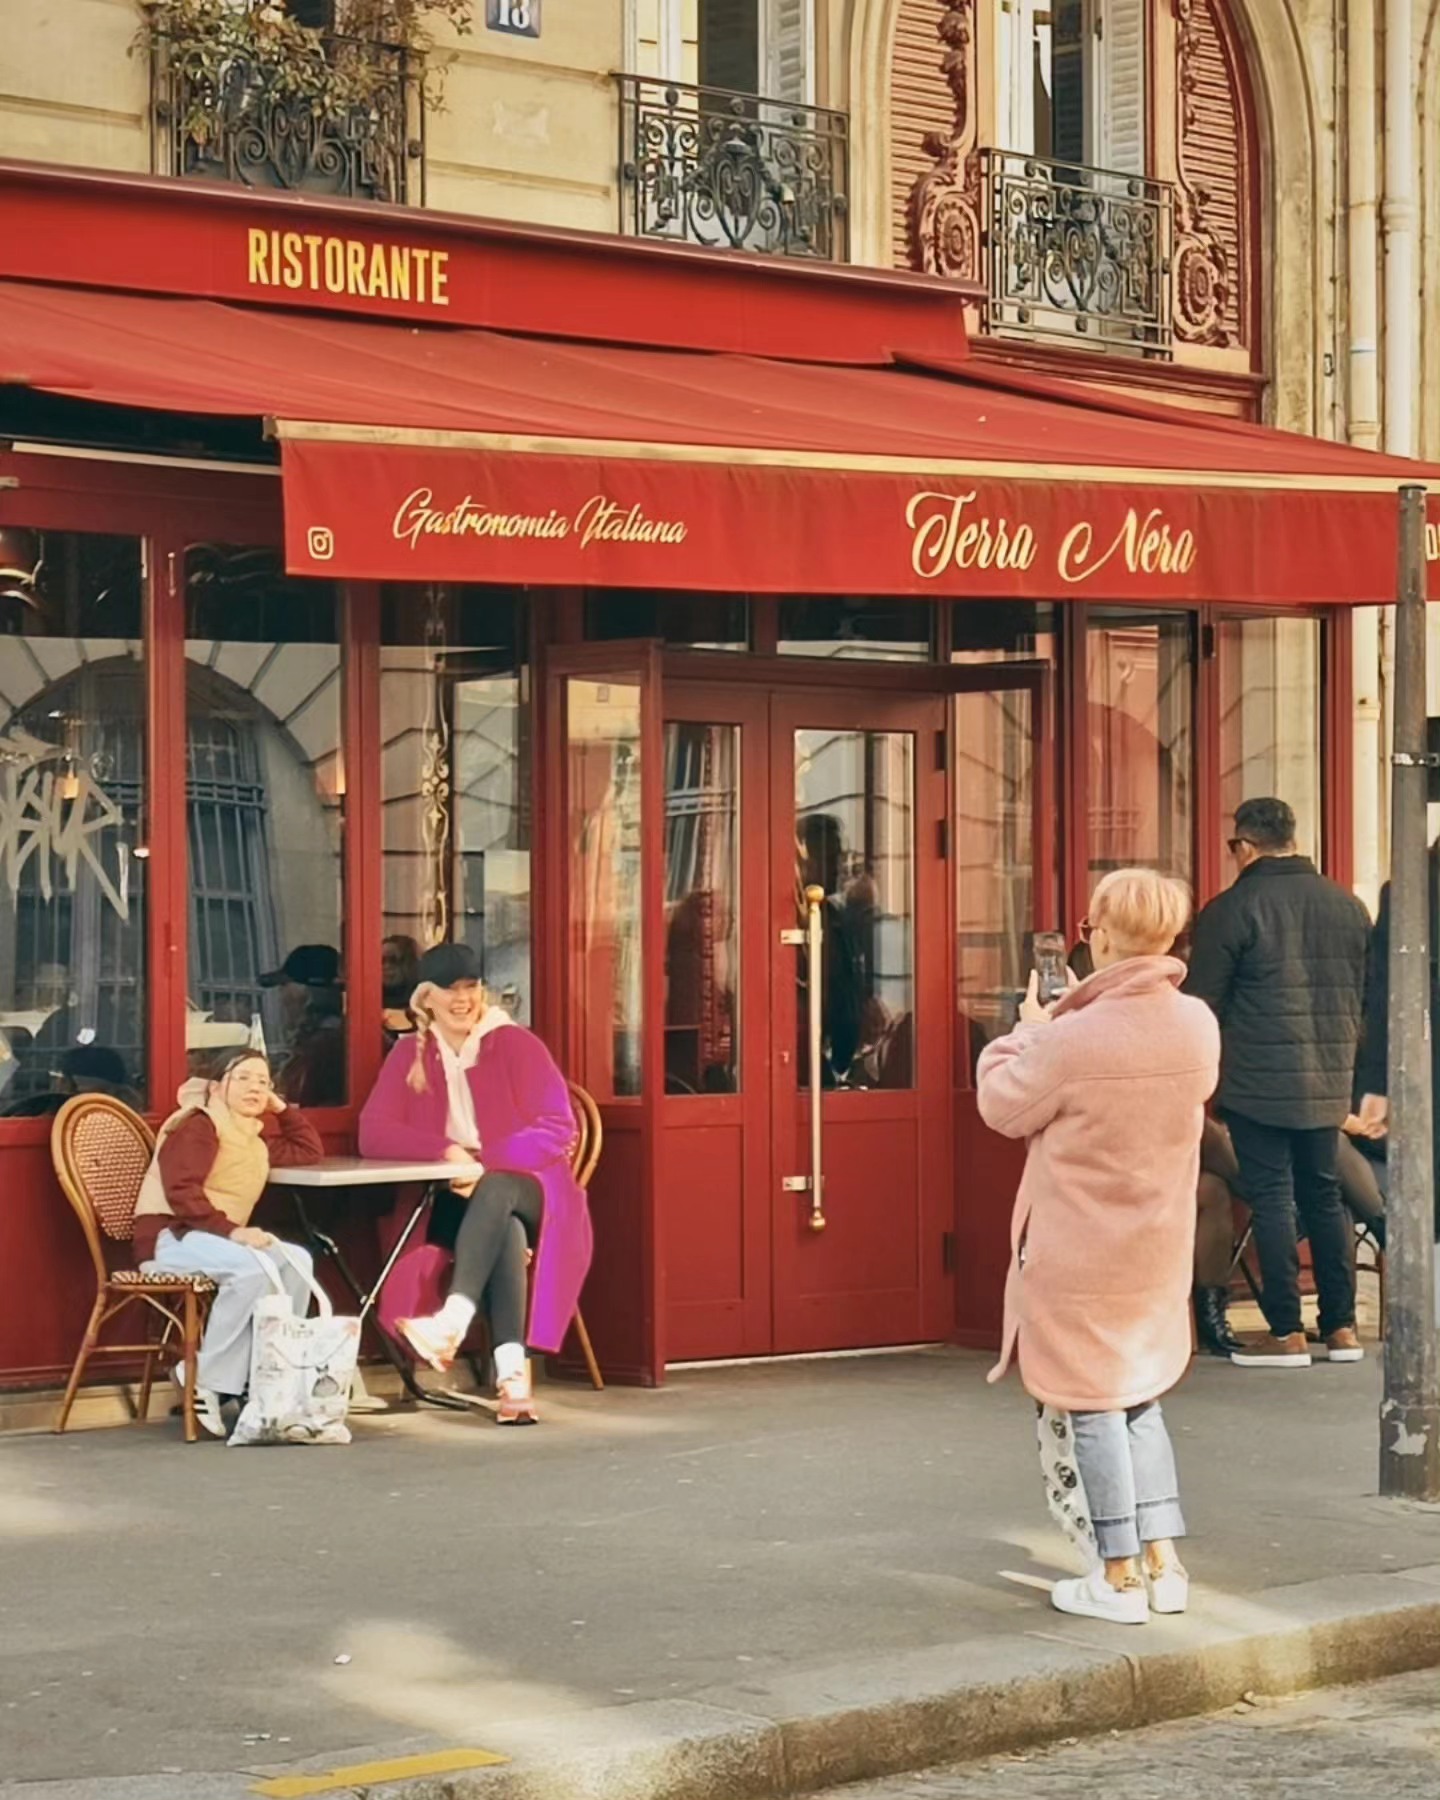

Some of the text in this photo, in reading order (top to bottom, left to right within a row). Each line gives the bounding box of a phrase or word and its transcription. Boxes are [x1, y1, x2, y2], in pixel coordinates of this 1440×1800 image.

[248, 228, 449, 305] RISTORANTE
[393, 487, 688, 550] Gastronomia Italiana
[906, 490, 1197, 582] Terra Nera
